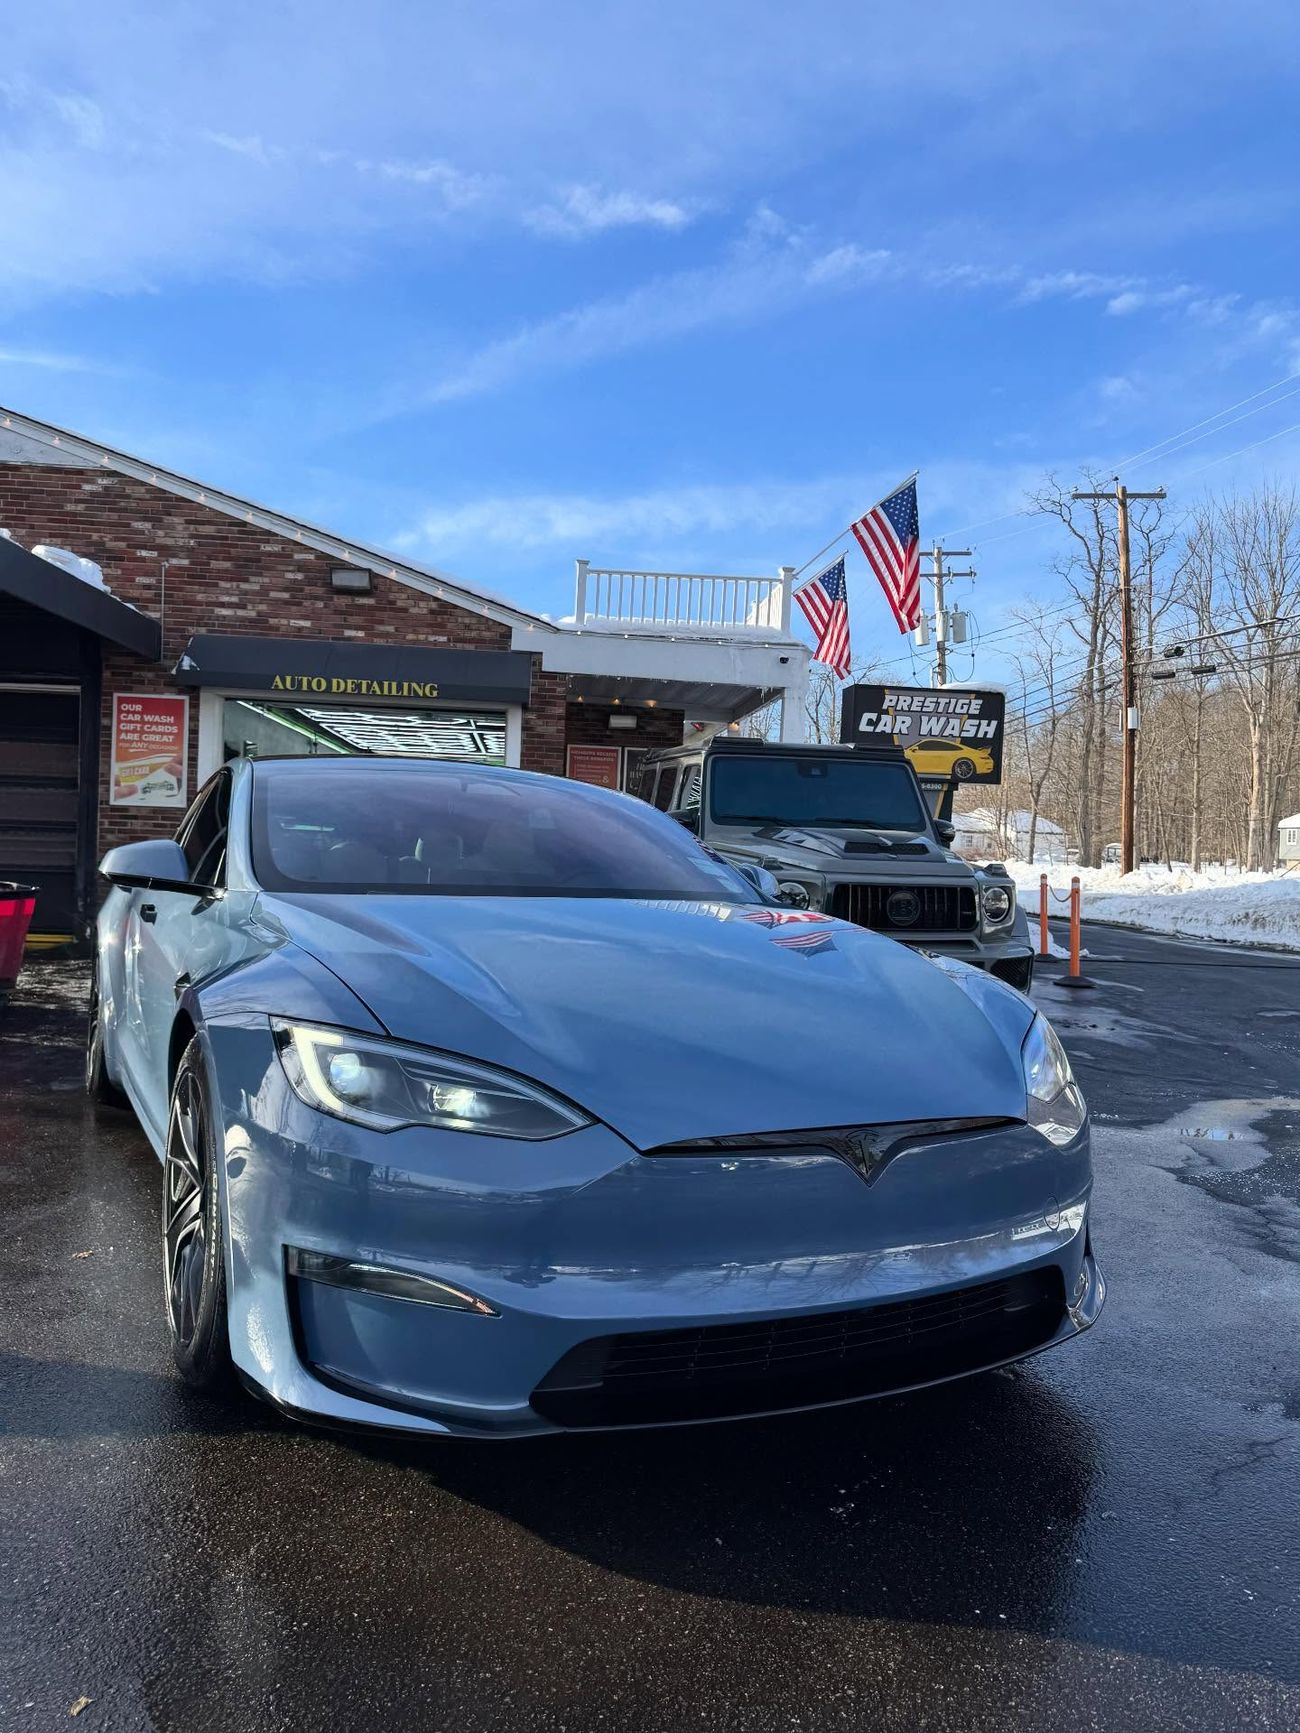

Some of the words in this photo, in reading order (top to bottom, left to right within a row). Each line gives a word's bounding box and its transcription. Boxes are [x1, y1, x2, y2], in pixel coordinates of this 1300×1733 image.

[271, 674, 327, 692] AUTO
[331, 678, 439, 698] DETAILING
[882, 694, 984, 715] PRESTIGE
[143, 715, 174, 723] WASH
[858, 712, 913, 735] CAR
[918, 715, 998, 739] WASH
[120, 732, 140, 740] ARE
[144, 724, 178, 733] CARDS
